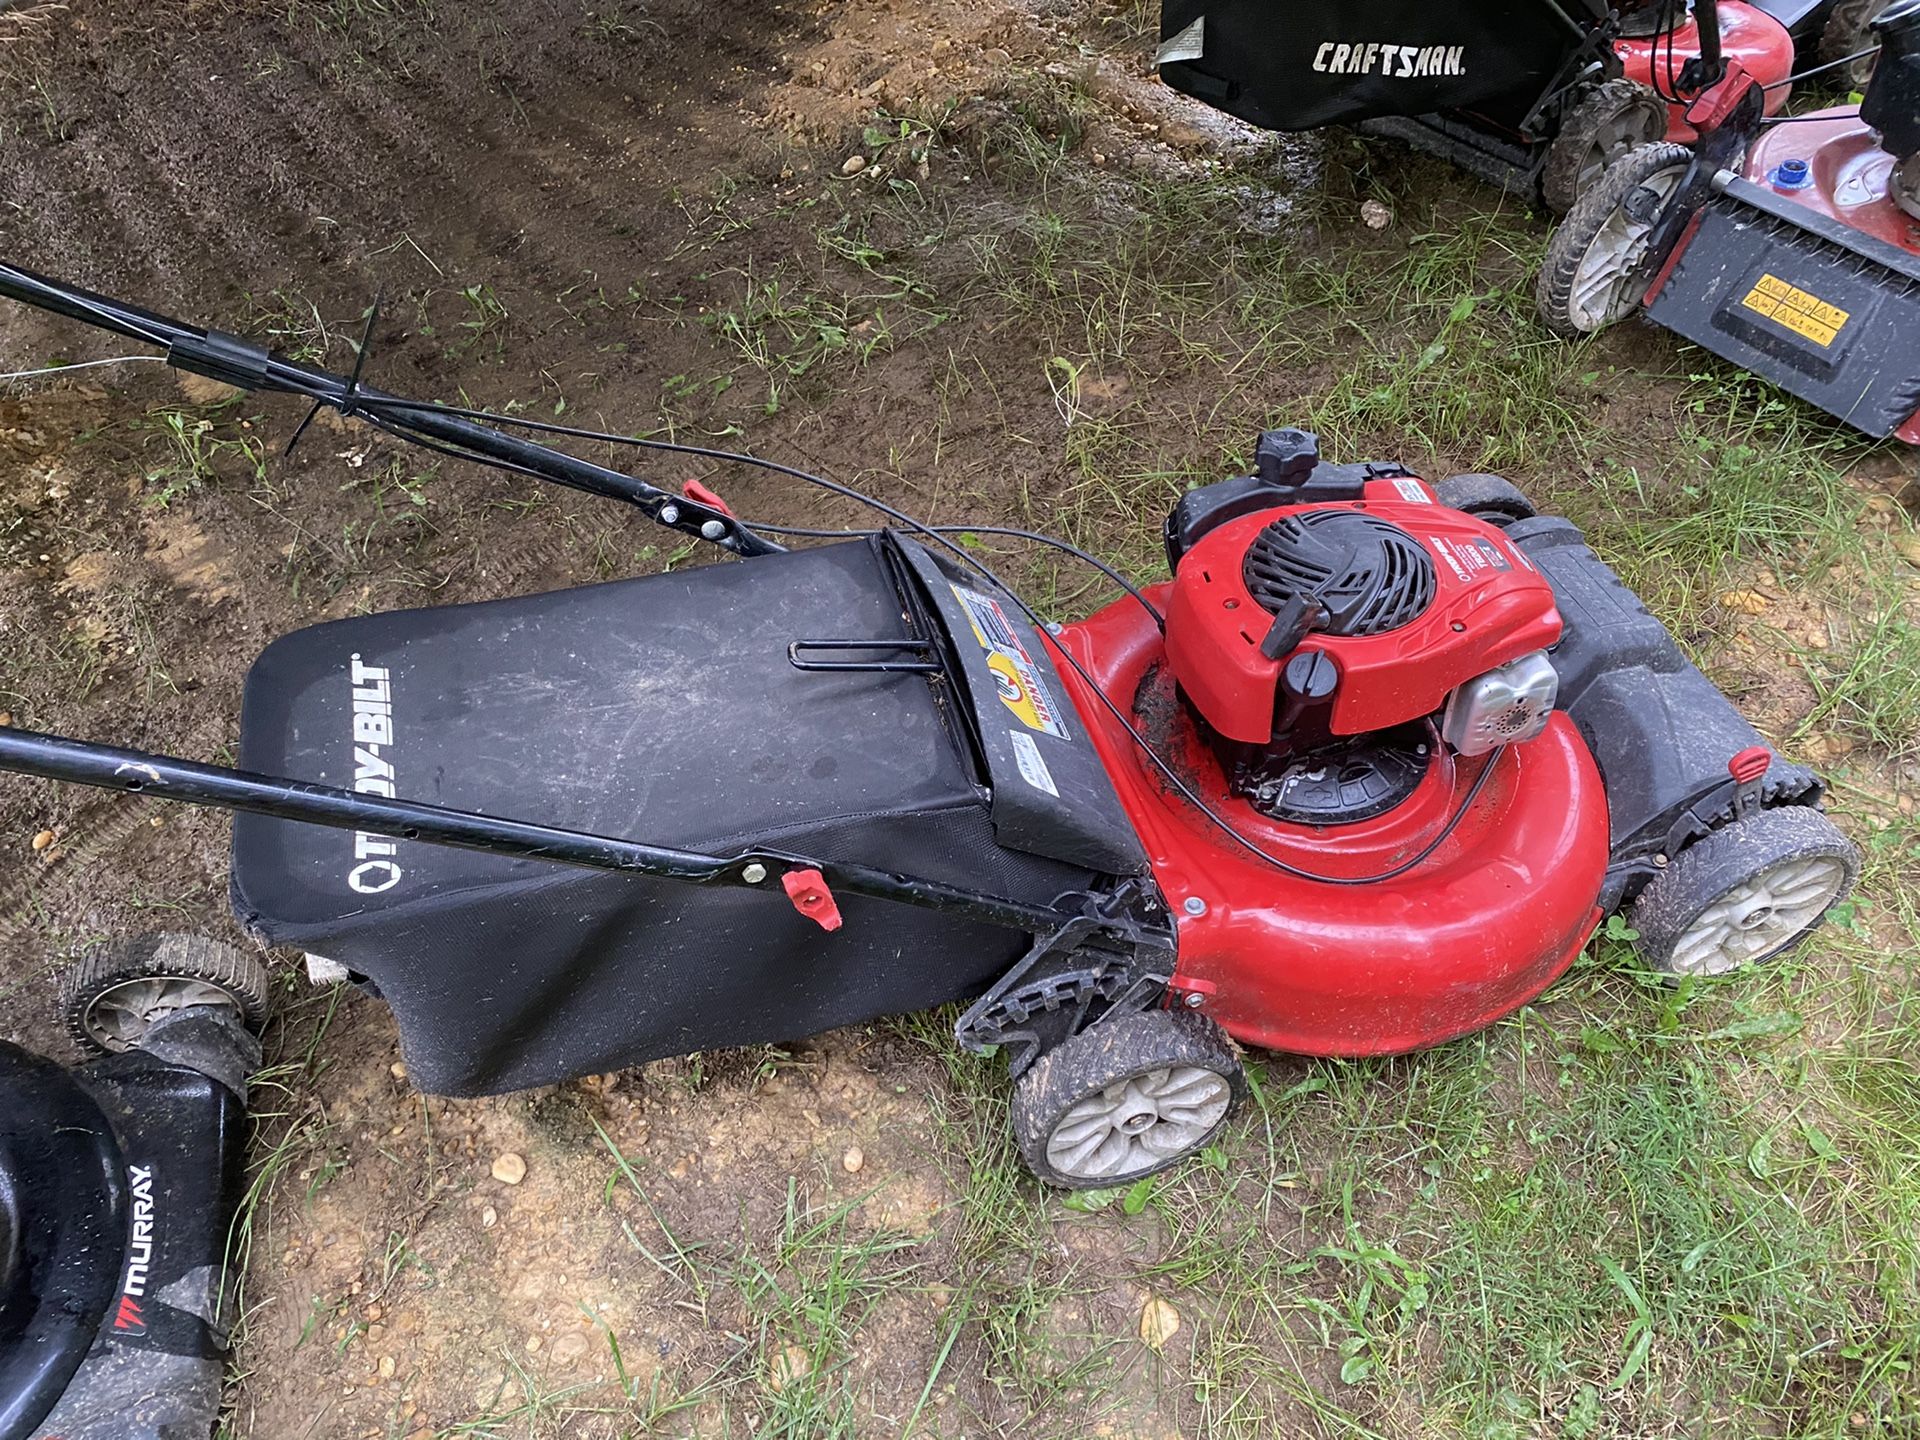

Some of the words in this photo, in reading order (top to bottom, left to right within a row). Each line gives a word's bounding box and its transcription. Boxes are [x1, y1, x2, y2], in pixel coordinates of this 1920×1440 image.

[1312, 42, 1463, 78] CRAFTSMAN
[1019, 669, 1051, 722] DANGER
[124, 1165, 154, 1296] MURRAY
